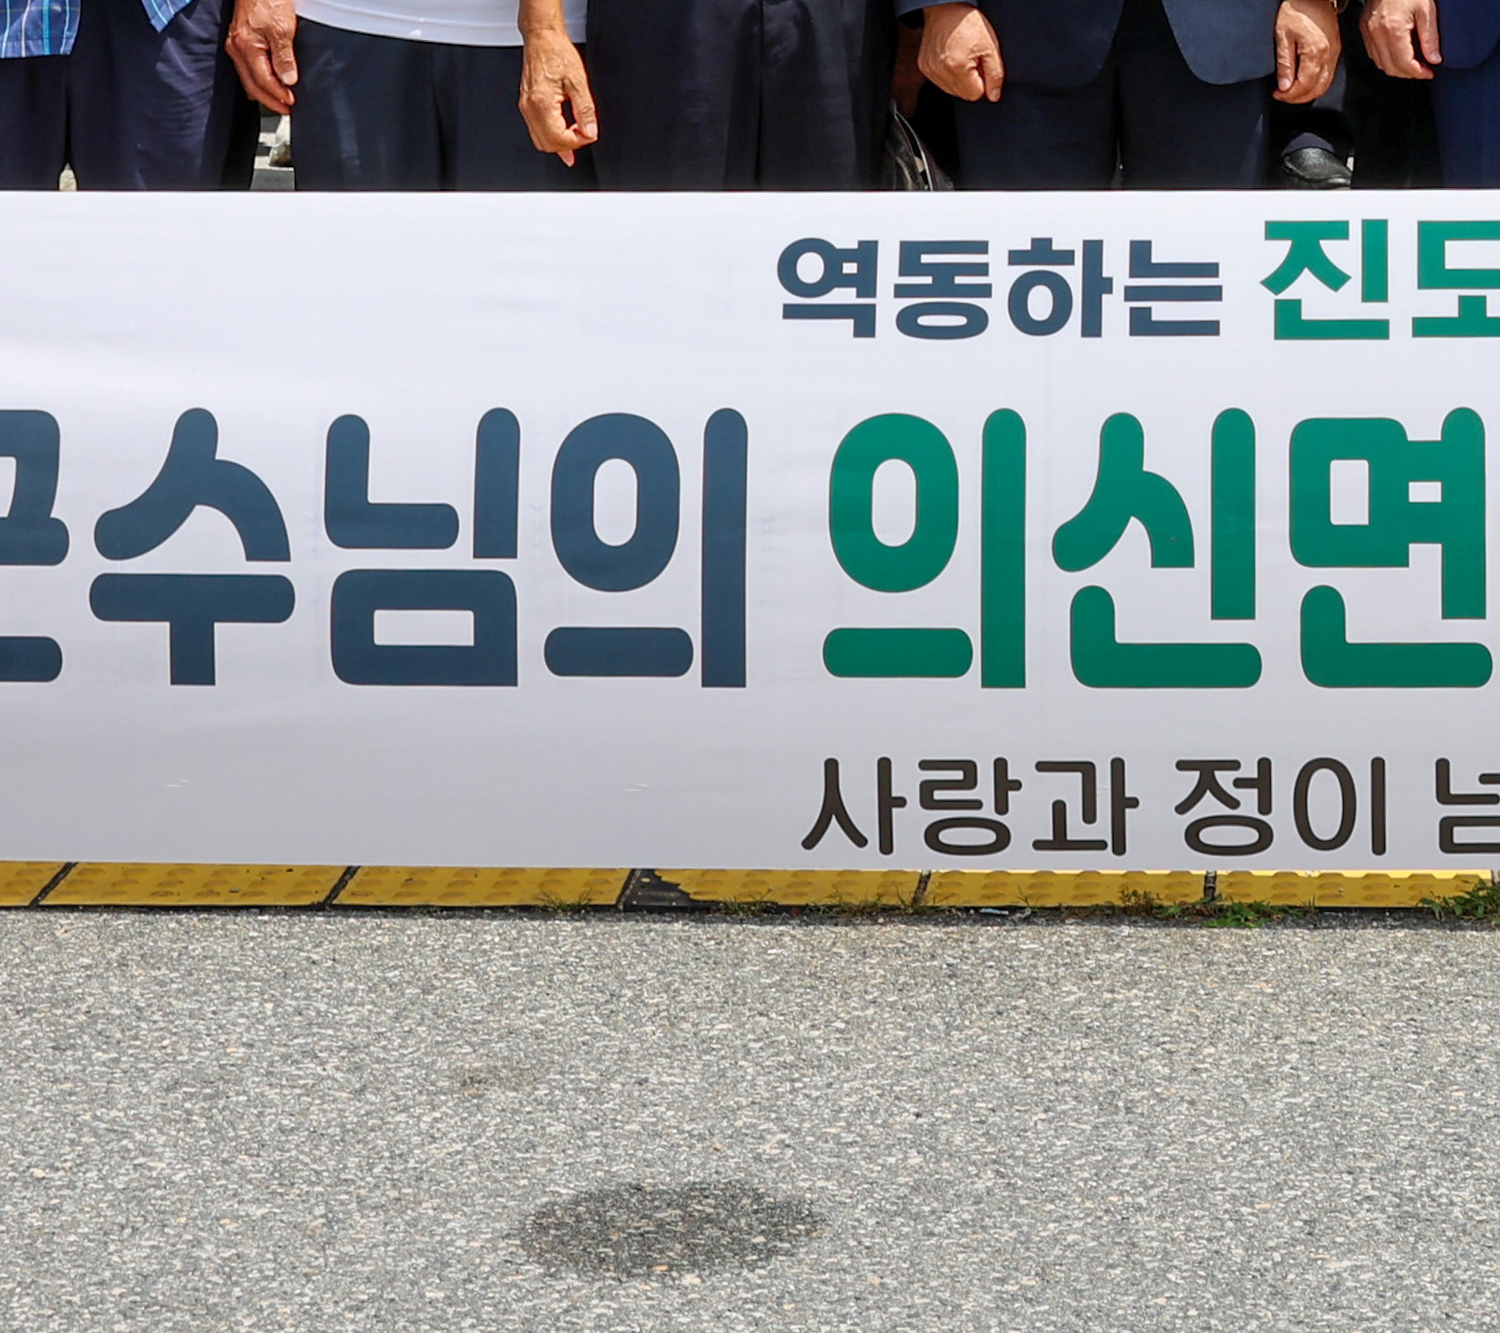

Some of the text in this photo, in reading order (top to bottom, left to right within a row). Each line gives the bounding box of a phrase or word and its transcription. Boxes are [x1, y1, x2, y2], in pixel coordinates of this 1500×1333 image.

[778, 239, 1222, 339] 역동하는
[823, 408, 1492, 688] 의신면
[801, 757, 1139, 856] 사랑과
[1175, 757, 1386, 856] 정이
